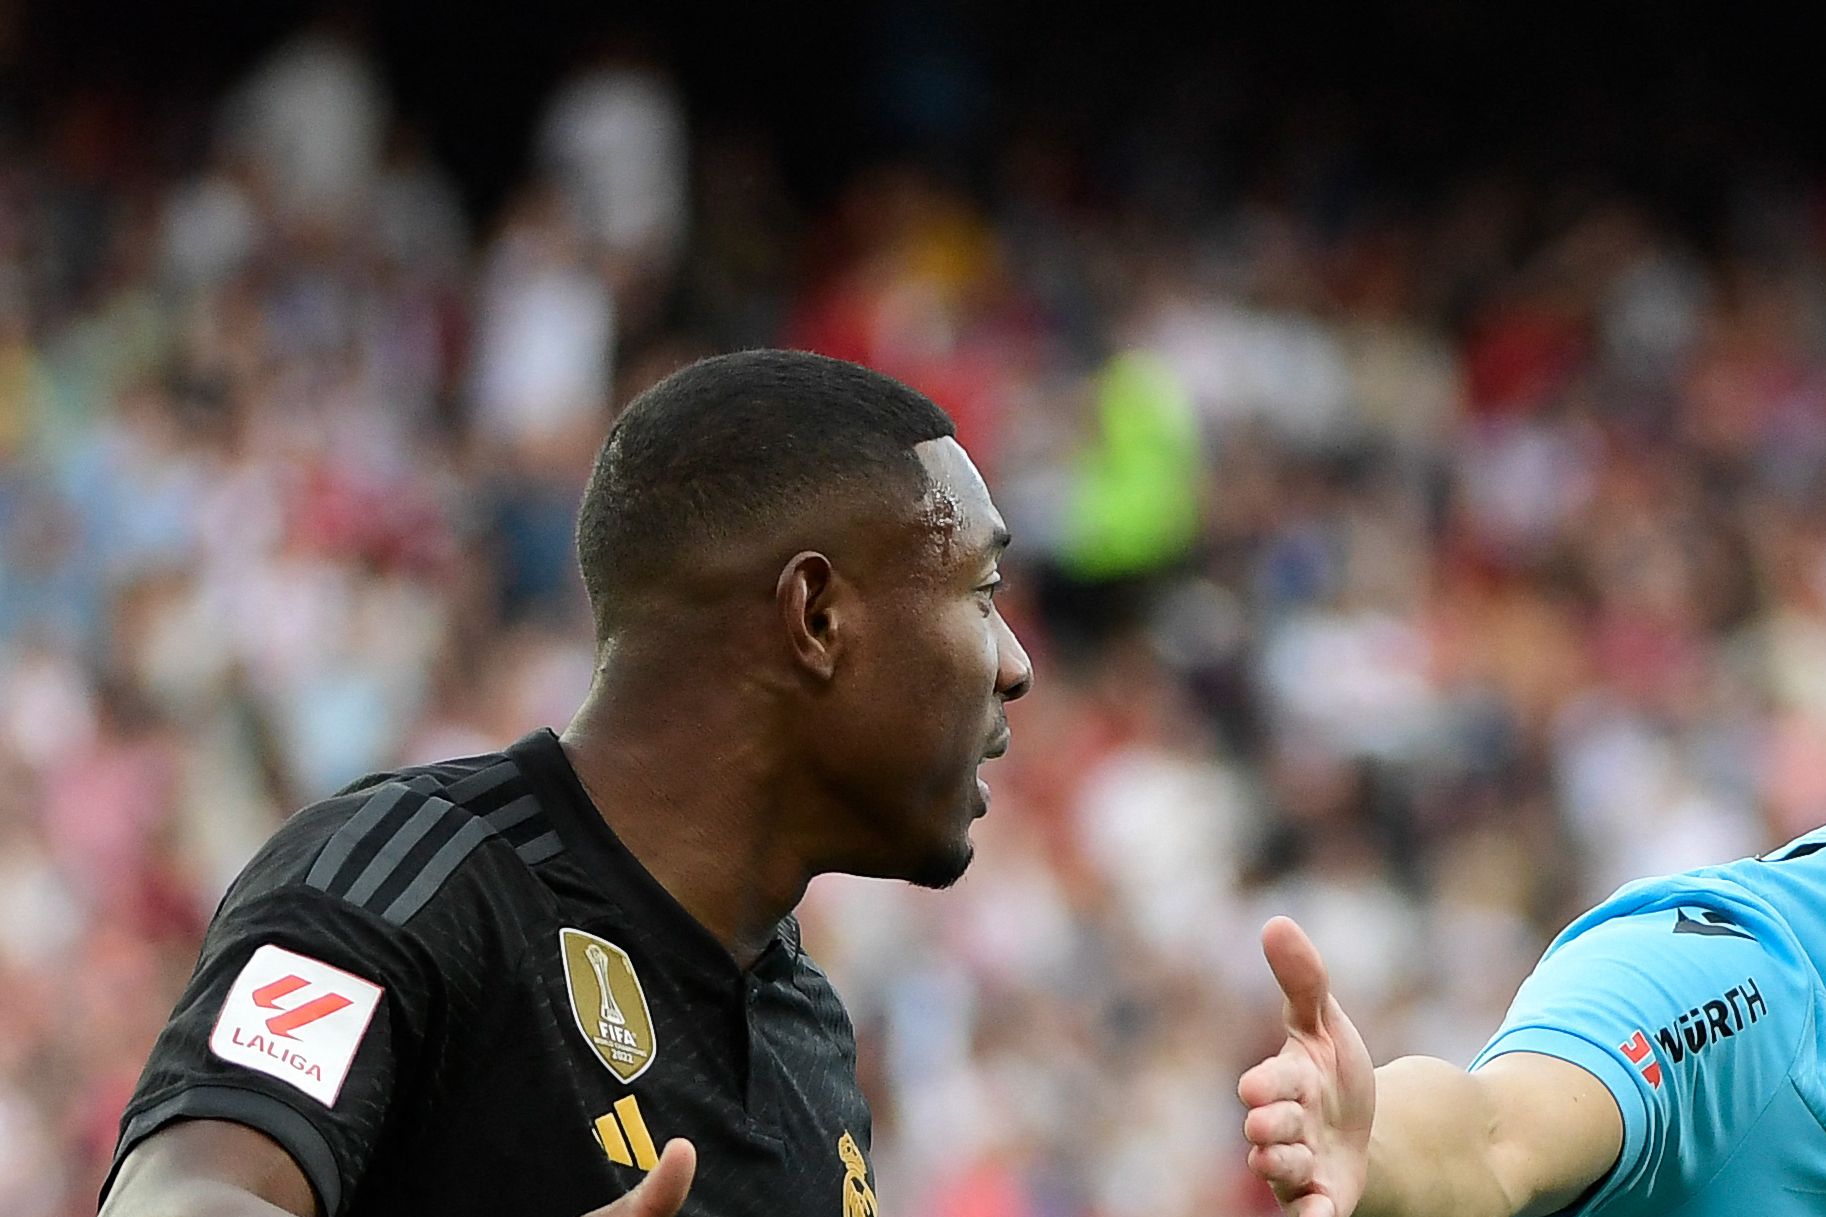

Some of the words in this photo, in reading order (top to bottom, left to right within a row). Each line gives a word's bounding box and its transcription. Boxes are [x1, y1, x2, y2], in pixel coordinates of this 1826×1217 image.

[600, 1022, 637, 1047] FIFA
[1654, 976, 1767, 1064] WÜRTH
[232, 1027, 322, 1082] LALIGA
[611, 1049, 635, 1064] 2022
